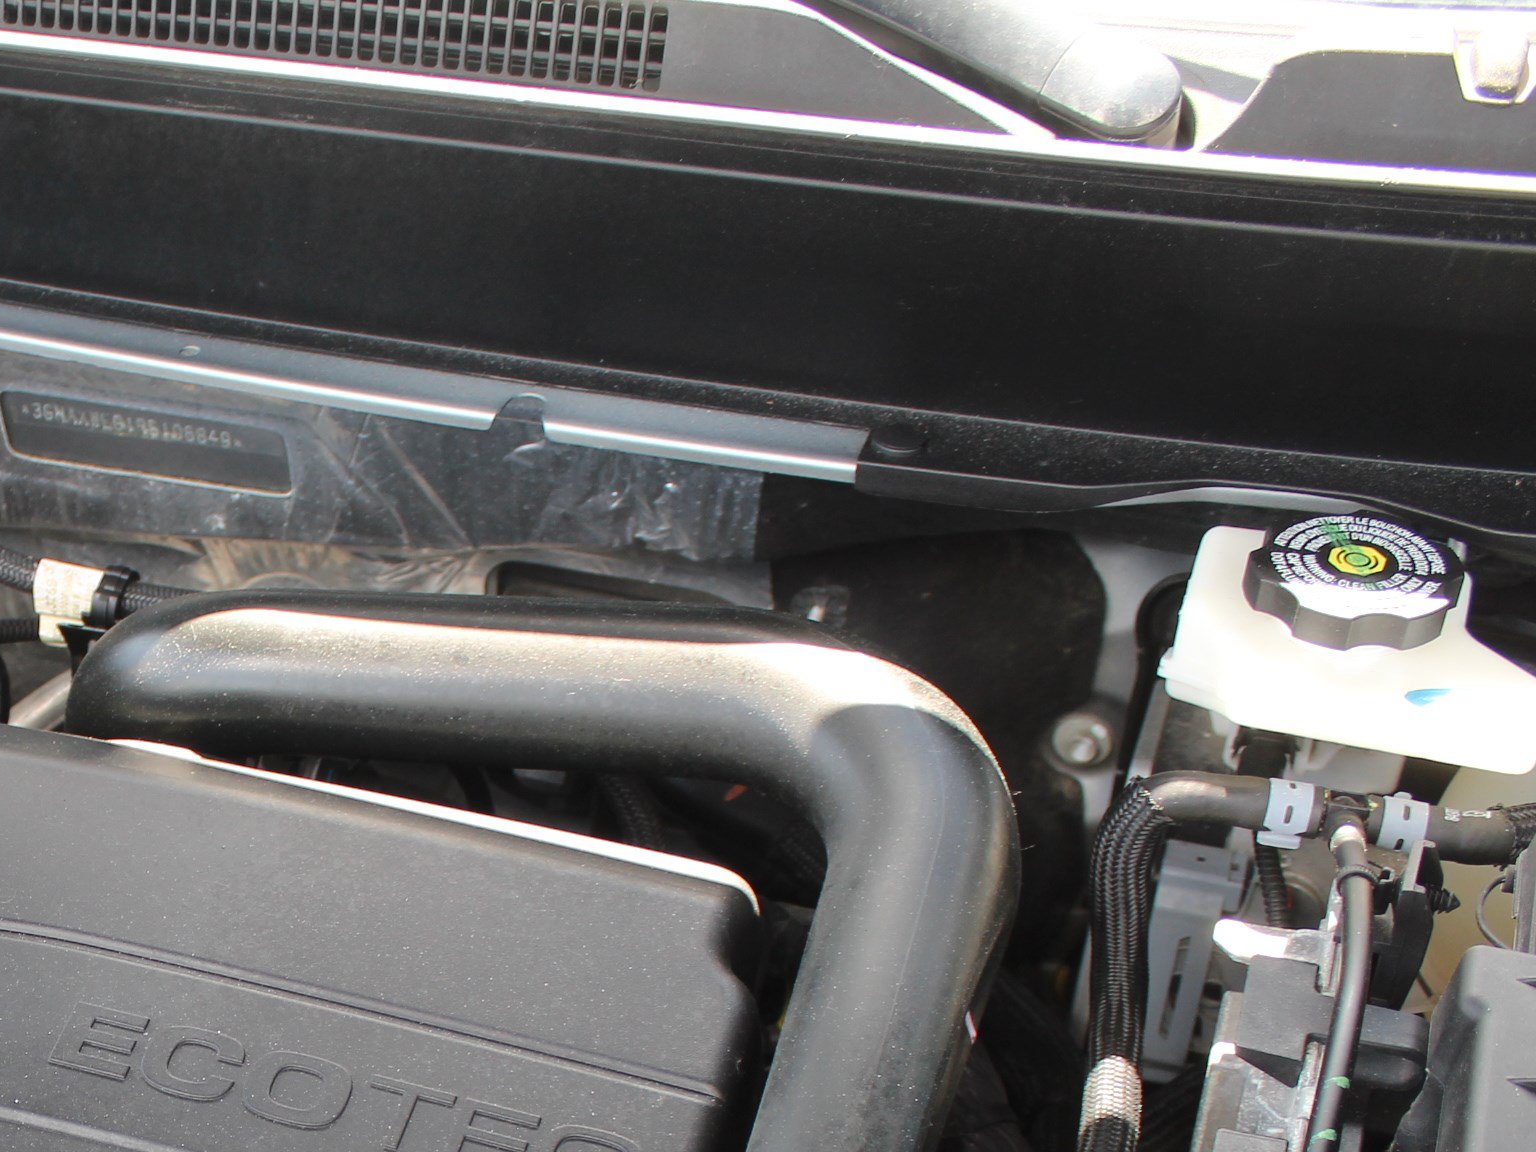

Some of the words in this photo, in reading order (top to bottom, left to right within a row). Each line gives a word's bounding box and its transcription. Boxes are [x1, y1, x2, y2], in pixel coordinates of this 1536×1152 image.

[1348, 524, 1363, 532] DU
[1355, 517, 1369, 525] LE
[1369, 519, 1414, 538] BOUCHON
